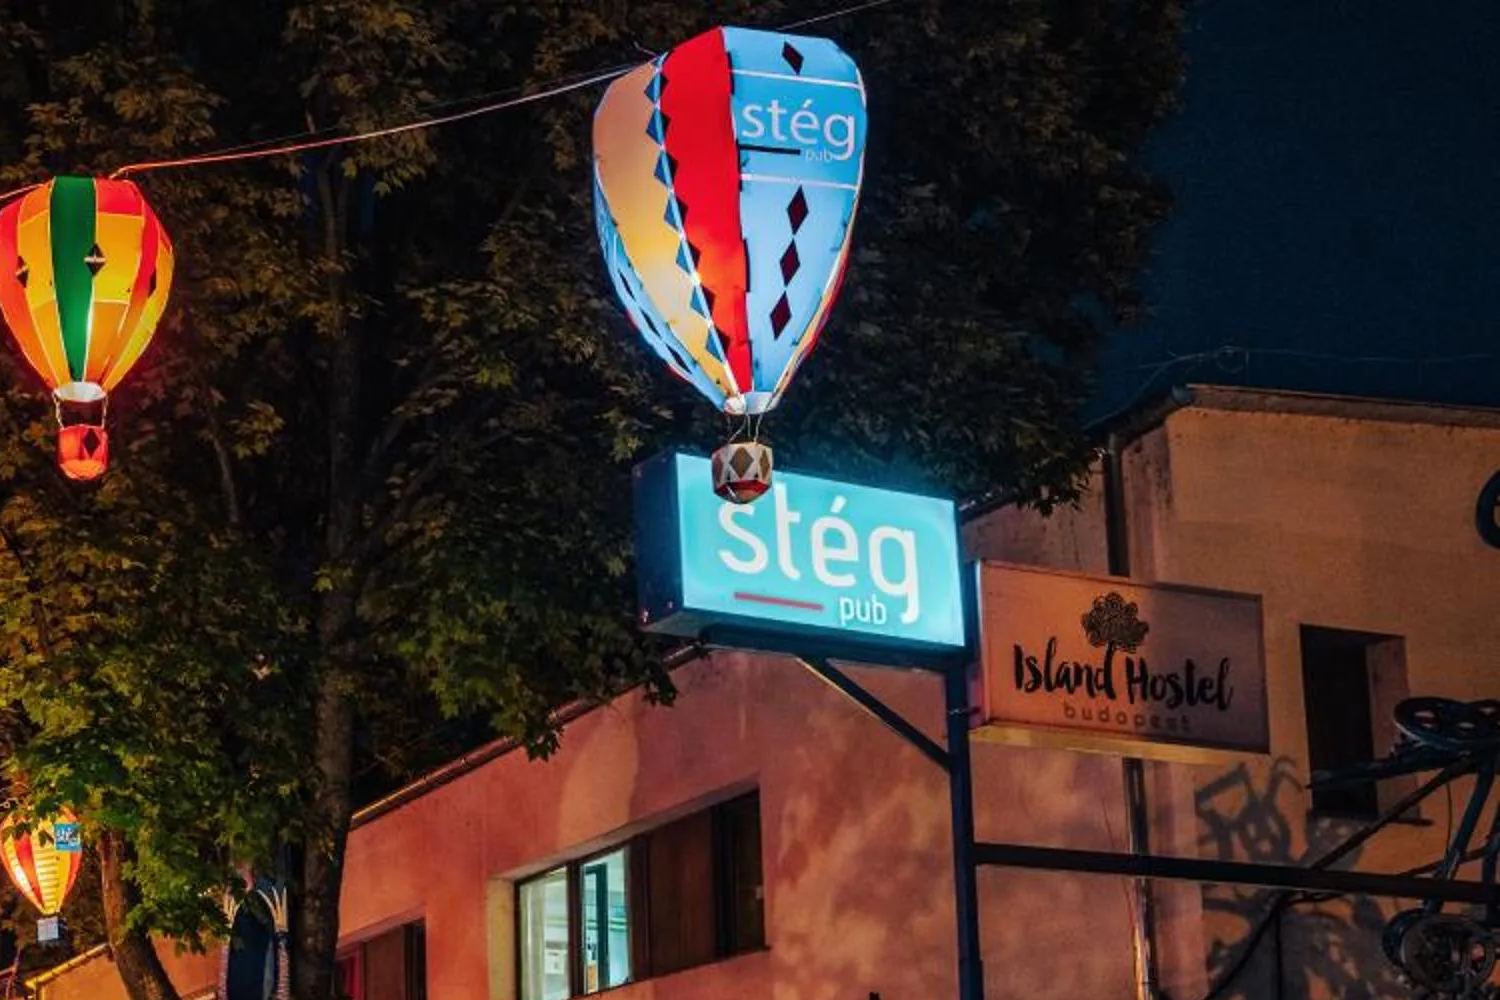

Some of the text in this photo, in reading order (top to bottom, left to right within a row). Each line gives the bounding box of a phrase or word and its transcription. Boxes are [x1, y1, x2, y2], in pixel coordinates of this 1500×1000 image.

[741, 98, 856, 160] stég
[805, 147, 832, 163] pub
[717, 481, 920, 625] stég
[839, 594, 887, 626] pub
[1013, 635, 1235, 712] Island Hostel
[1062, 701, 1192, 733] budapest
